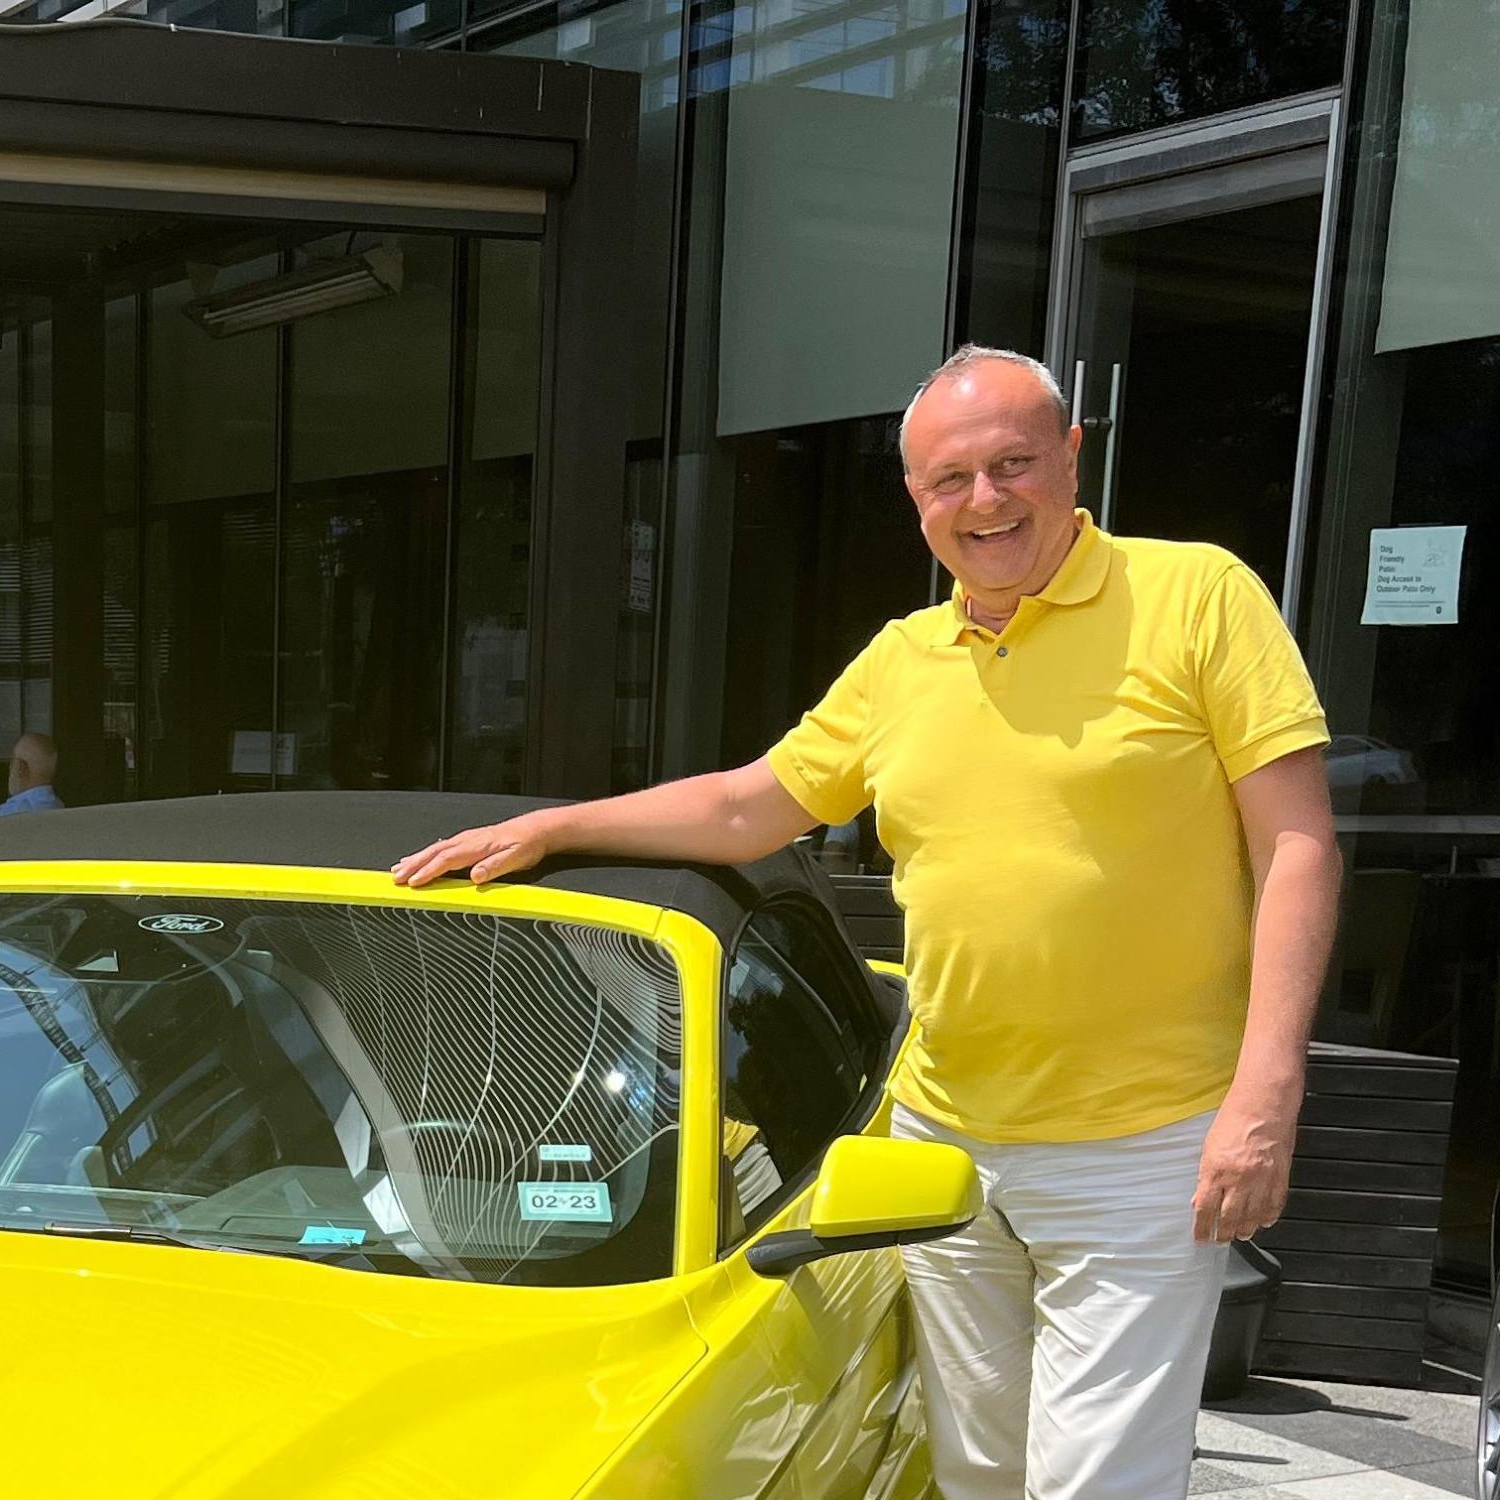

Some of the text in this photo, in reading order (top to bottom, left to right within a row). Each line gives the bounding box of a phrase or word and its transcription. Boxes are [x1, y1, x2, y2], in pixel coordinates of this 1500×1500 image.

[1380, 545, 1394, 554] Dog
[1377, 576, 1390, 584] Dog
[1420, 585, 1436, 594] Only
[151, 916, 210, 930] Ford
